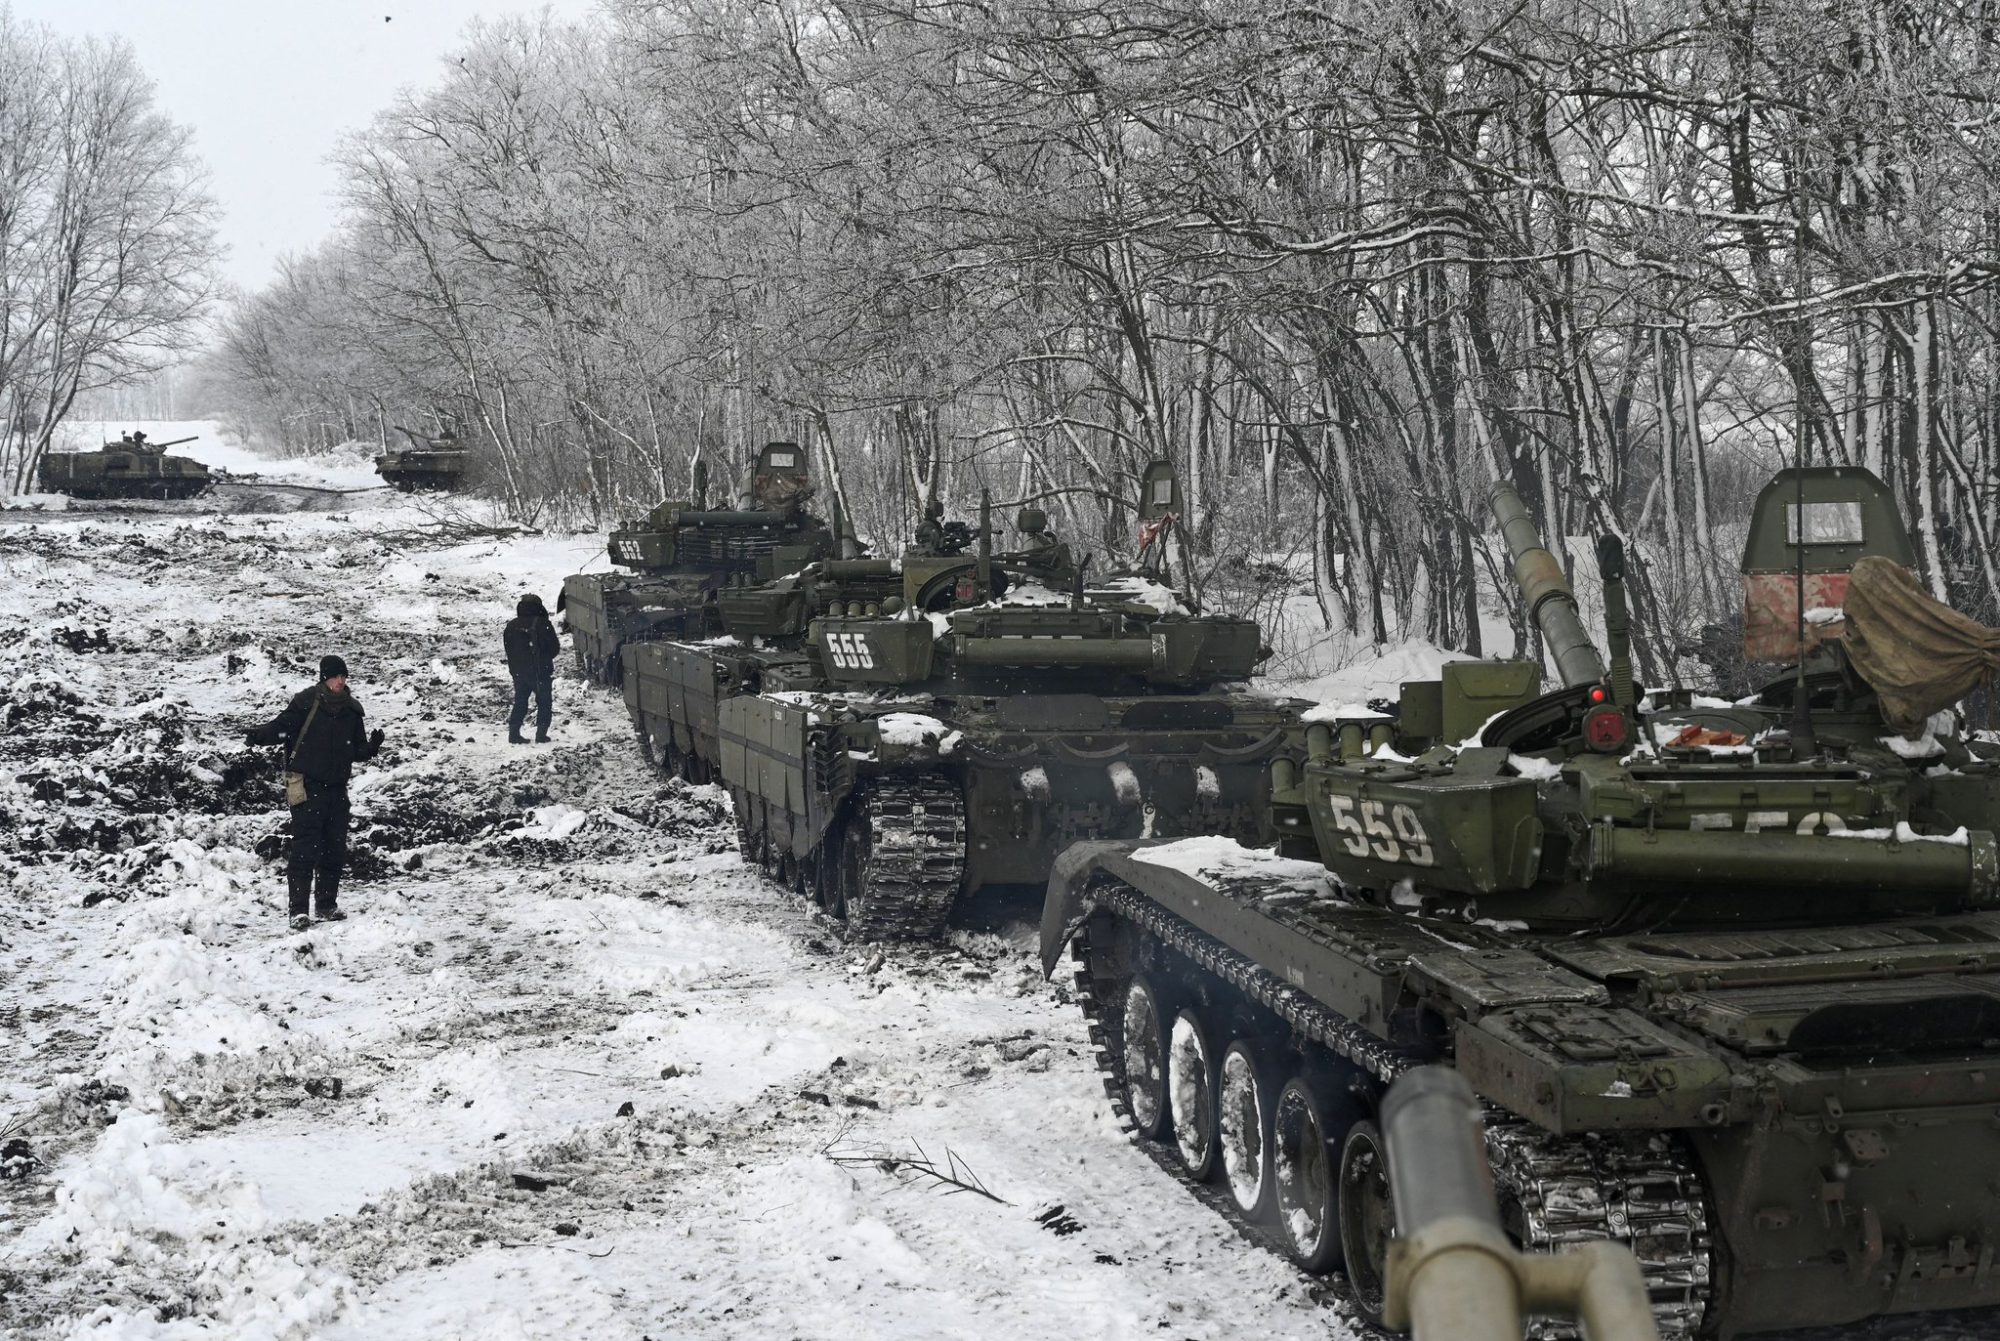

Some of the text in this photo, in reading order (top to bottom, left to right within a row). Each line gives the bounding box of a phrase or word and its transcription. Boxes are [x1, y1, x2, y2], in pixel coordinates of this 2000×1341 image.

[618, 540, 644, 560] 552
[826, 633, 874, 670] 555
[1329, 795, 1434, 867] 559
